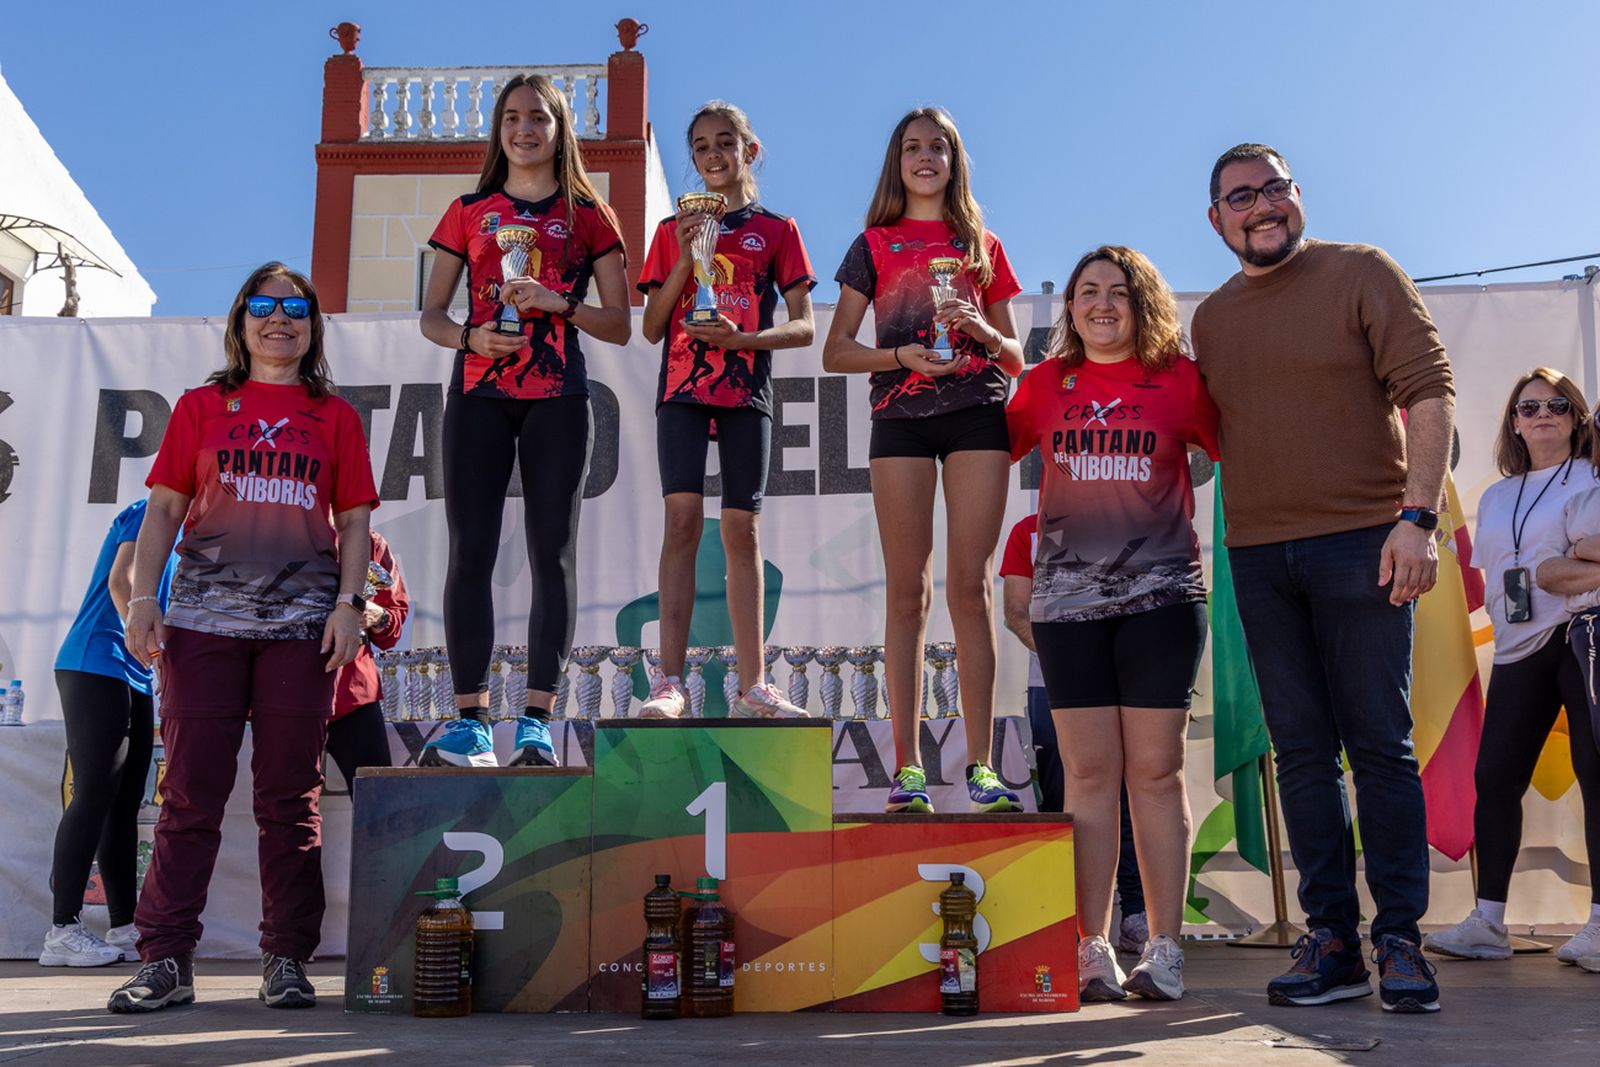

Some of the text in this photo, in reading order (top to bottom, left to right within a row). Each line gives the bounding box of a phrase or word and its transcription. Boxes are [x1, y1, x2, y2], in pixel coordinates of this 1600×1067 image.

[1064, 404, 1144, 420] CROSS
[228, 423, 312, 445] CROSS
[1053, 429, 1157, 455] PANTANO
[217, 448, 321, 482] PANTANO
[1054, 450, 1152, 482] DEL VÍBORAS
[220, 471, 317, 510] DEL VÍBORAS
[686, 782, 726, 880] 1
[442, 831, 504, 930] 2
[918, 863, 991, 963] 3
[742, 962, 826, 972] DEPORTES
